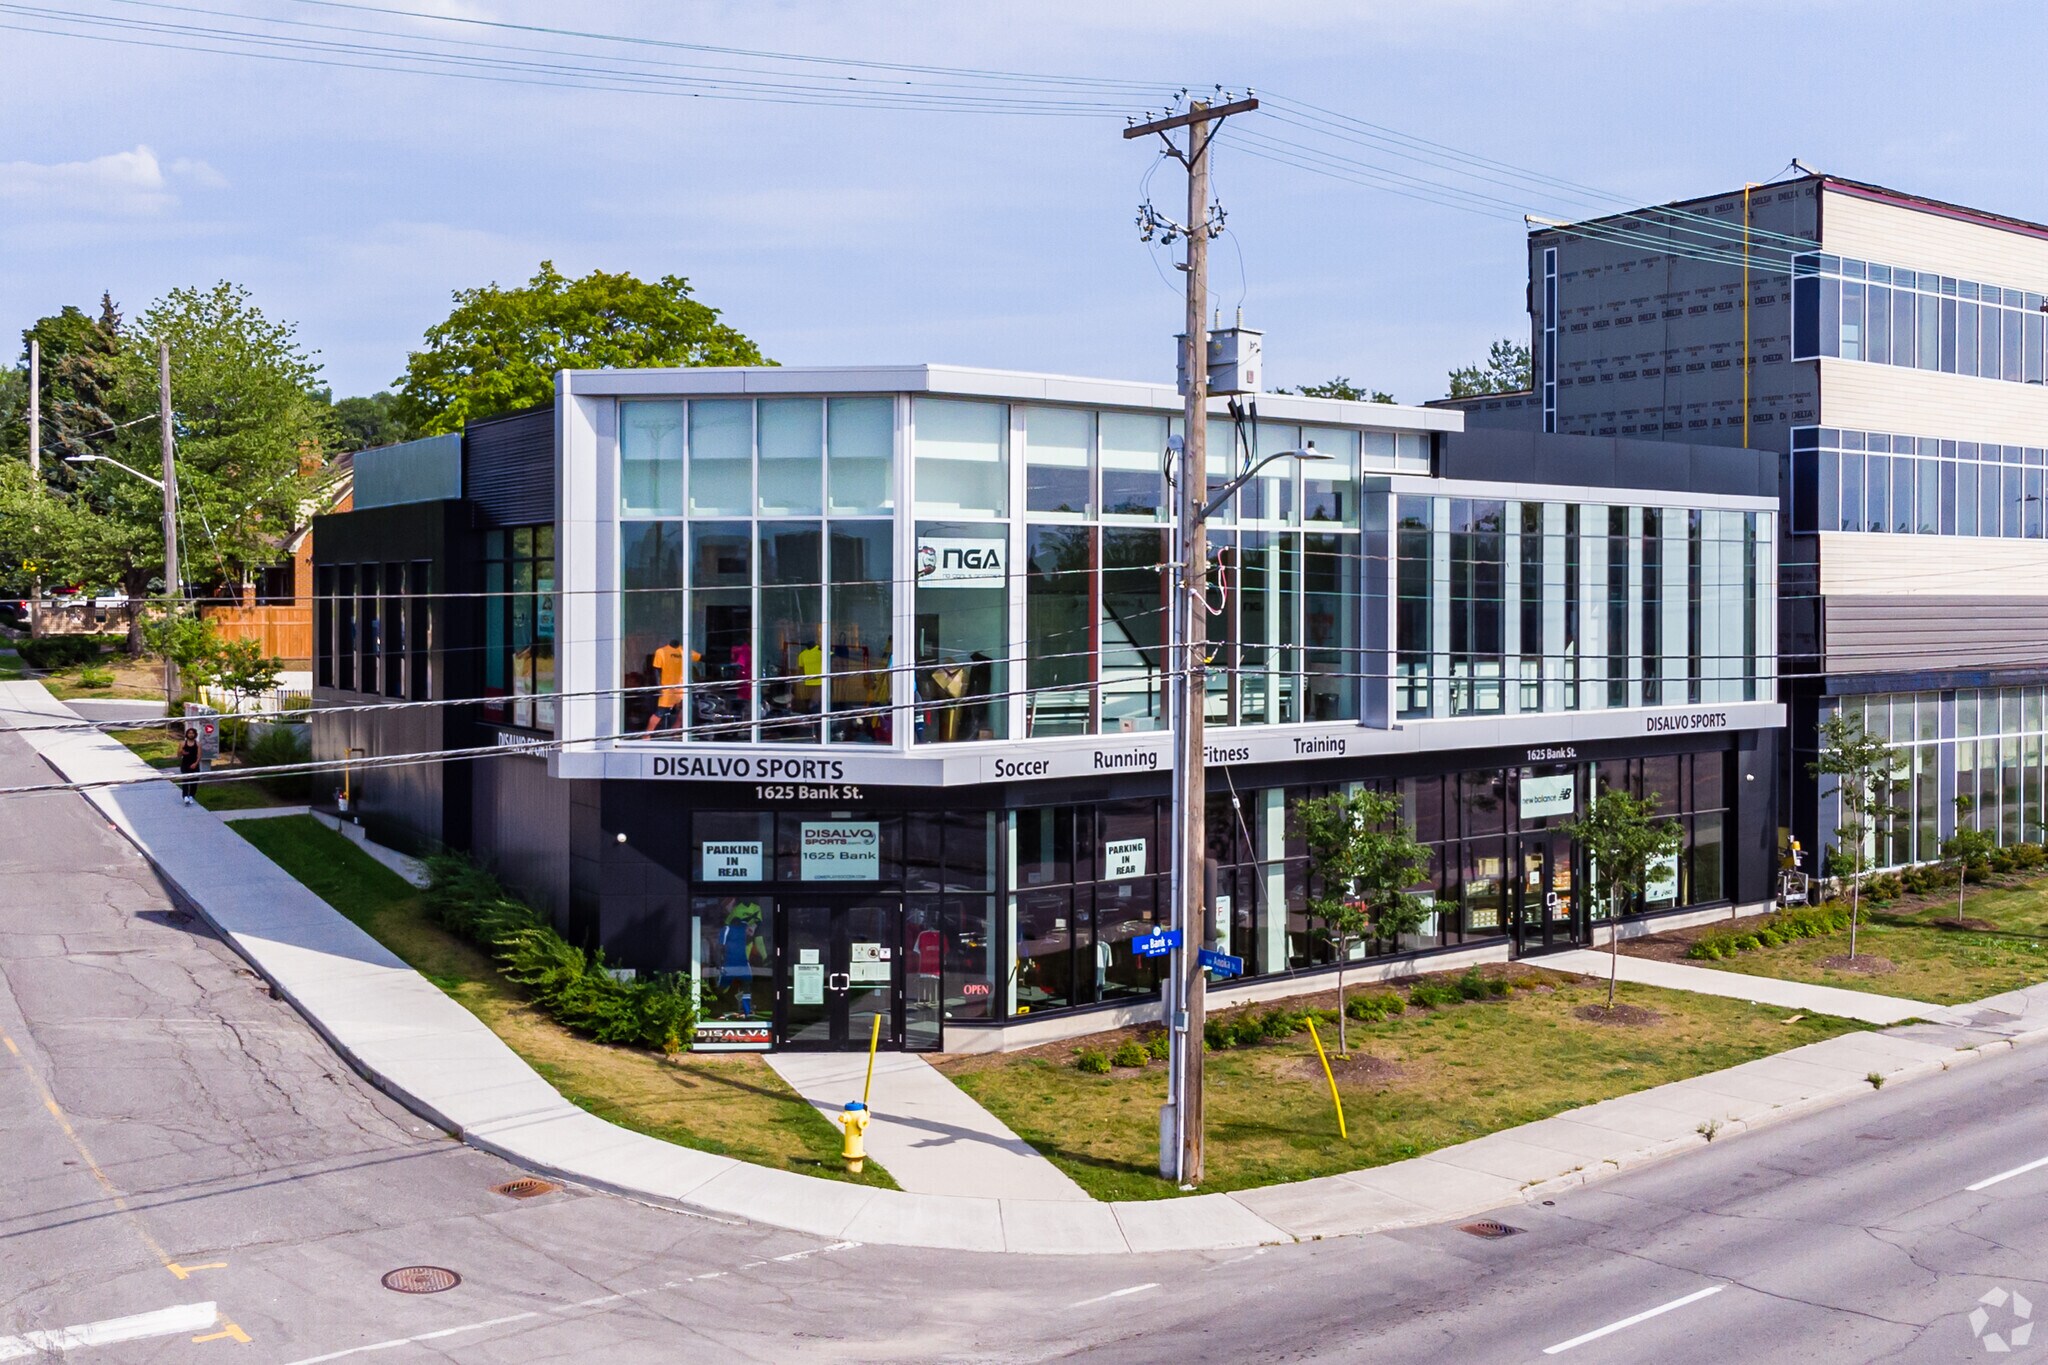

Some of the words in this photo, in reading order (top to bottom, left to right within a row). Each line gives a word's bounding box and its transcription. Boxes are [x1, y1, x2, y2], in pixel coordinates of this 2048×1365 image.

[1714, 202, 1734, 213] DELTA
[1752, 196, 1772, 206] DELTA
[1778, 190, 1799, 200] DELTA
[1571, 323, 1588, 331] DELTA
[1592, 320, 1610, 329] DELTA
[1614, 316, 1633, 326] DELTA
[1638, 313, 1656, 322] DELTA
[1688, 305, 1707, 314] DELTA
[1713, 302, 1733, 311] DELTA
[1755, 295, 1776, 305] DELTA
[1578, 376, 1595, 384] DELTA
[1619, 370, 1637, 379] DELTA
[1642, 368, 1660, 377] DELTA
[1686, 363, 1705, 372] DELTA
[1711, 359, 1731, 369] DELTA
[1763, 354, 1783, 362] DELTA
[1640, 424, 1659, 432] DELTA
[1664, 422, 1682, 430] DELTA
[1689, 419, 1708, 428] DELTA
[1753, 413, 1773, 423] DELTA
[1792, 410, 1813, 419] DELTA
[1646, 716, 1689, 732] DISALVO
[1691, 713, 1726, 728] SPORTS
[1294, 736, 1346, 755] Training
[1094, 749, 1157, 769] Running
[1527, 749, 1545, 761] 1625
[1547, 748, 1566, 759] Bank
[1567, 747, 1577, 758] St.
[654, 757, 750, 777] DISALVO
[756, 759, 844, 779] SPORTS
[995, 759, 1049, 777] Soccer
[756, 786, 794, 799] 1625
[799, 786, 839, 799] Bank
[843, 786, 863, 799] St.
[1535, 794, 1556, 803] balance
[805, 829, 873, 838] DISALVO
[706, 845, 758, 854] PARKING
[1108, 843, 1143, 855] PARKING
[726, 857, 738, 866] IN
[804, 852, 834, 860] 1625
[840, 852, 876, 860] Bank
[718, 868, 747, 876] REAR
[1116, 865, 1135, 875] REAR
[1150, 936, 1165, 948] Bank
[963, 984, 989, 995] OPEN
